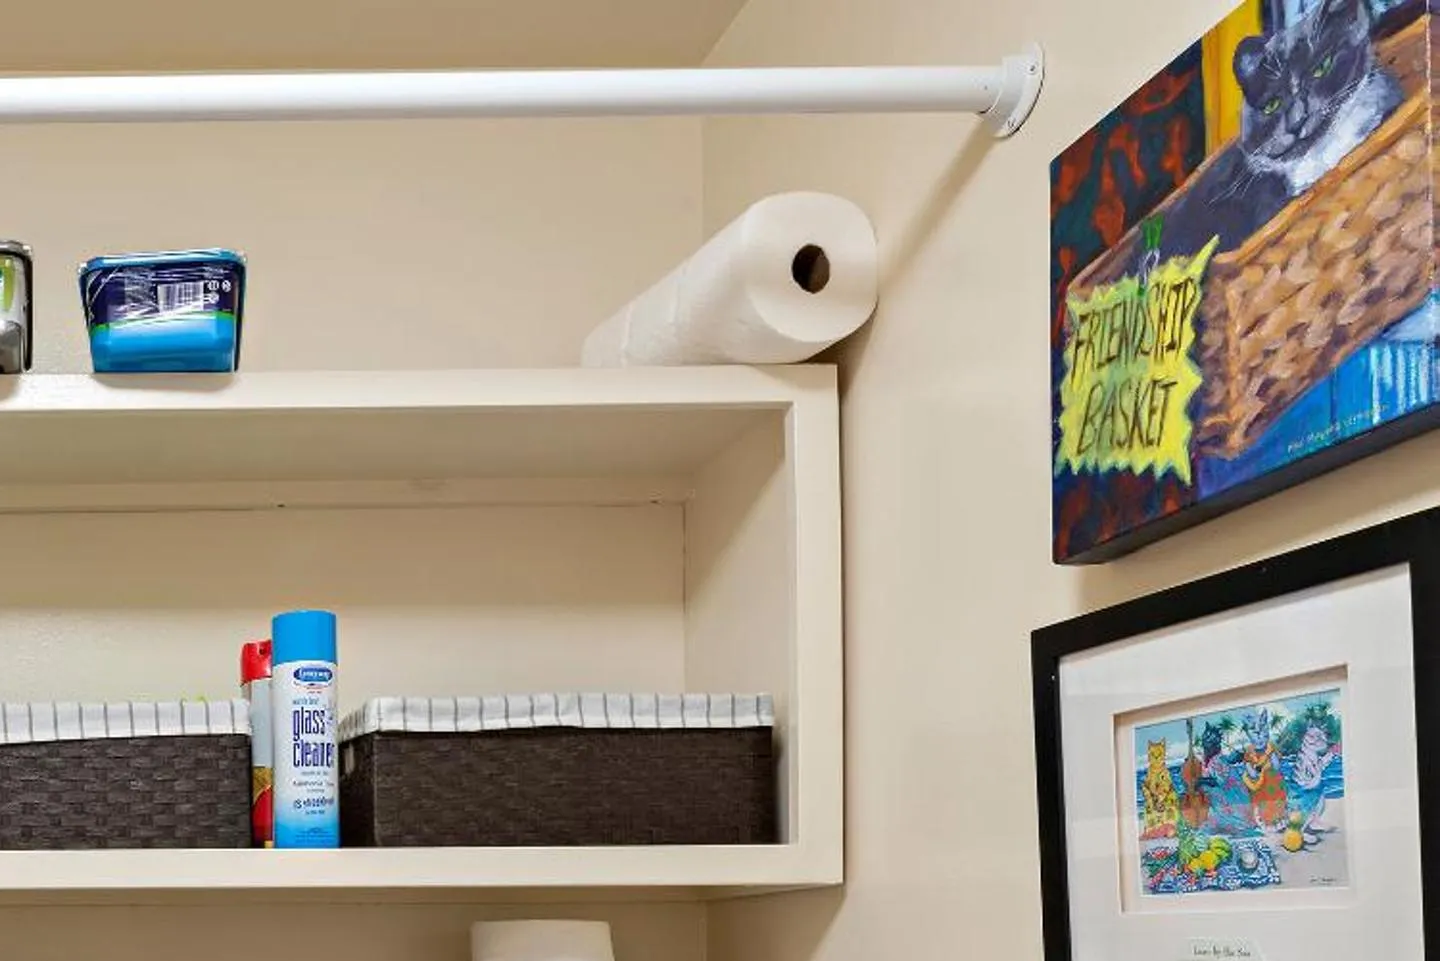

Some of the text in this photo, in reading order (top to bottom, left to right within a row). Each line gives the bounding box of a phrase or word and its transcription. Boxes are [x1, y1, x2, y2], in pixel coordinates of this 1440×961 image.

[1071, 276, 1196, 386] FRIENDSHIP
[1076, 379, 1178, 456] BASKET
[292, 706, 326, 741] glass
